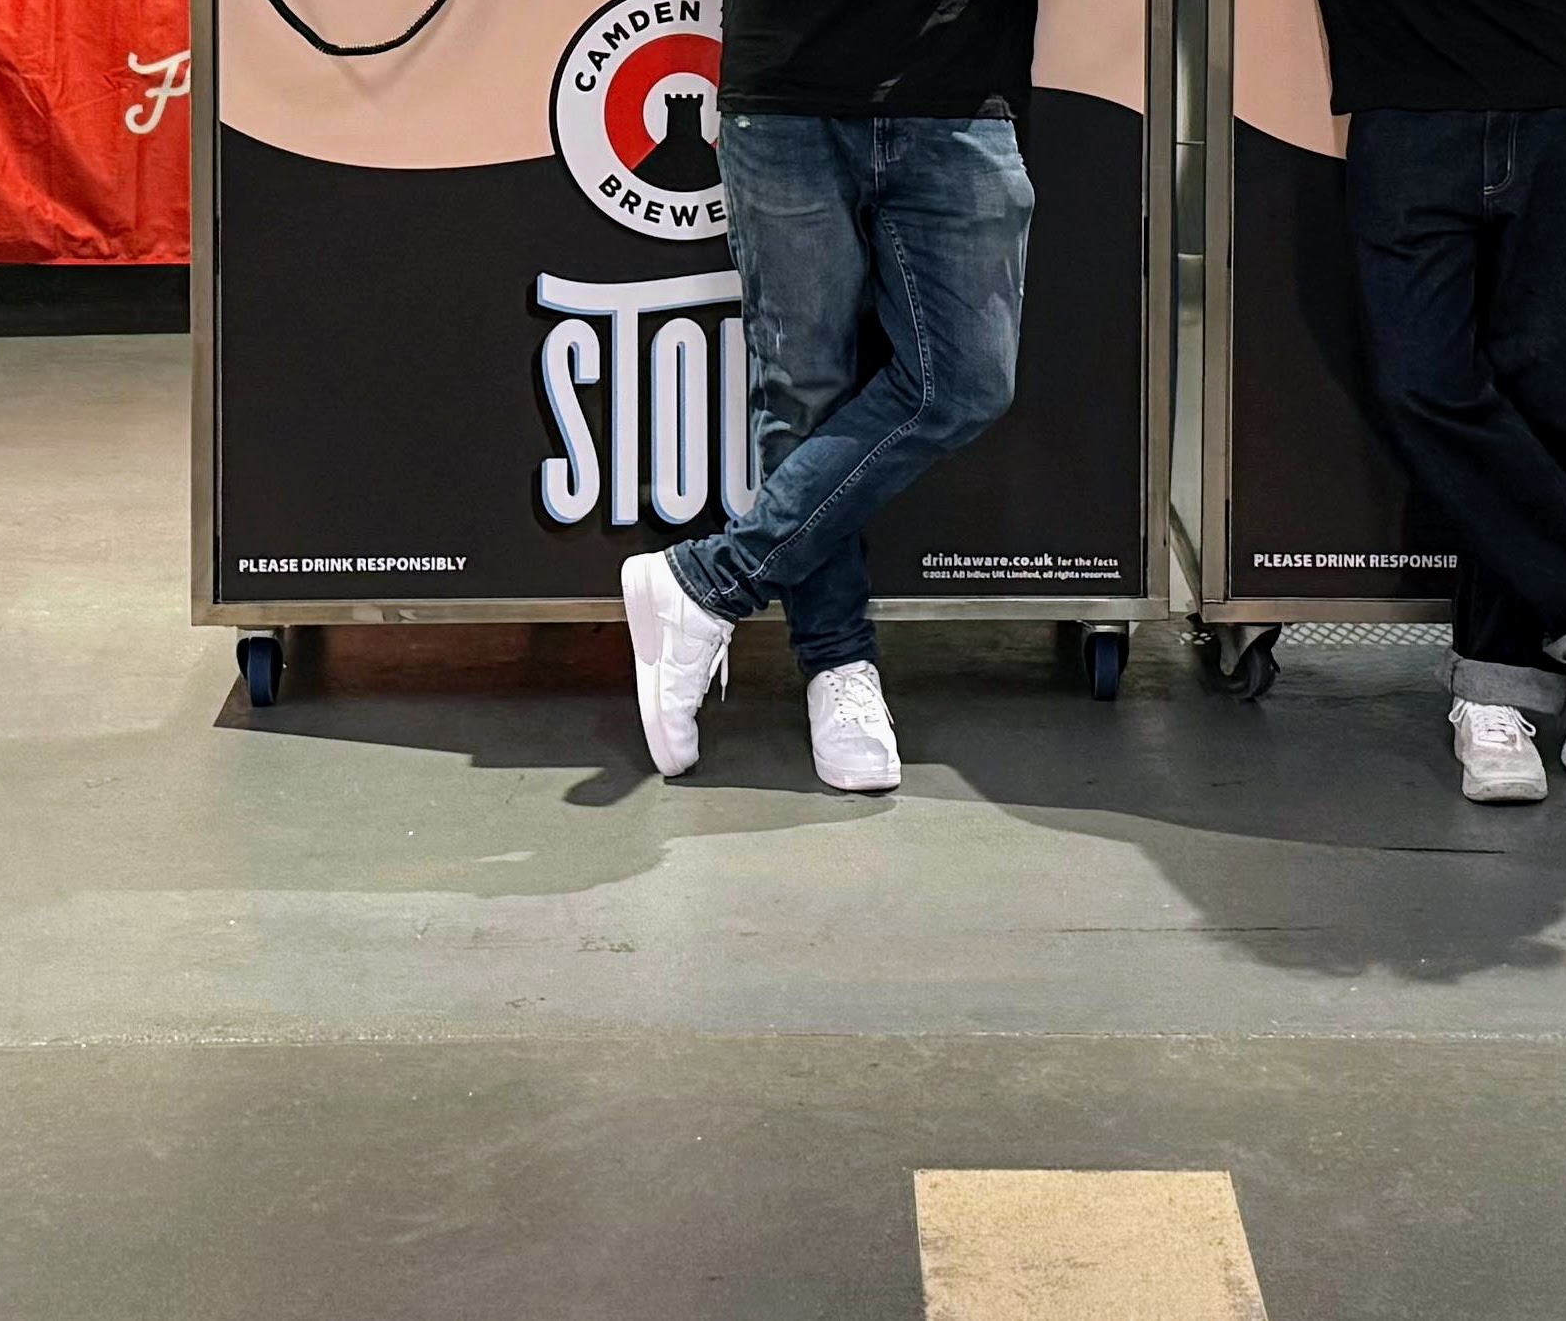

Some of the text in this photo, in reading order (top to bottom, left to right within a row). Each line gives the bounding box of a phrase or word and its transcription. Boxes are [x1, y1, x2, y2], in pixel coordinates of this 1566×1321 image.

[575, 0, 700, 92] CAMDEN
[238, 557, 466, 572] PLEASE DRINK RESPONSIBLY
[922, 553, 1118, 567] drinkaware.co.uk for the facts
[1253, 554, 1312, 567] PLEASE
[1316, 554, 1365, 568] DRINK
[992, 570, 1005, 579] UK
[1054, 570, 1079, 580] rights
